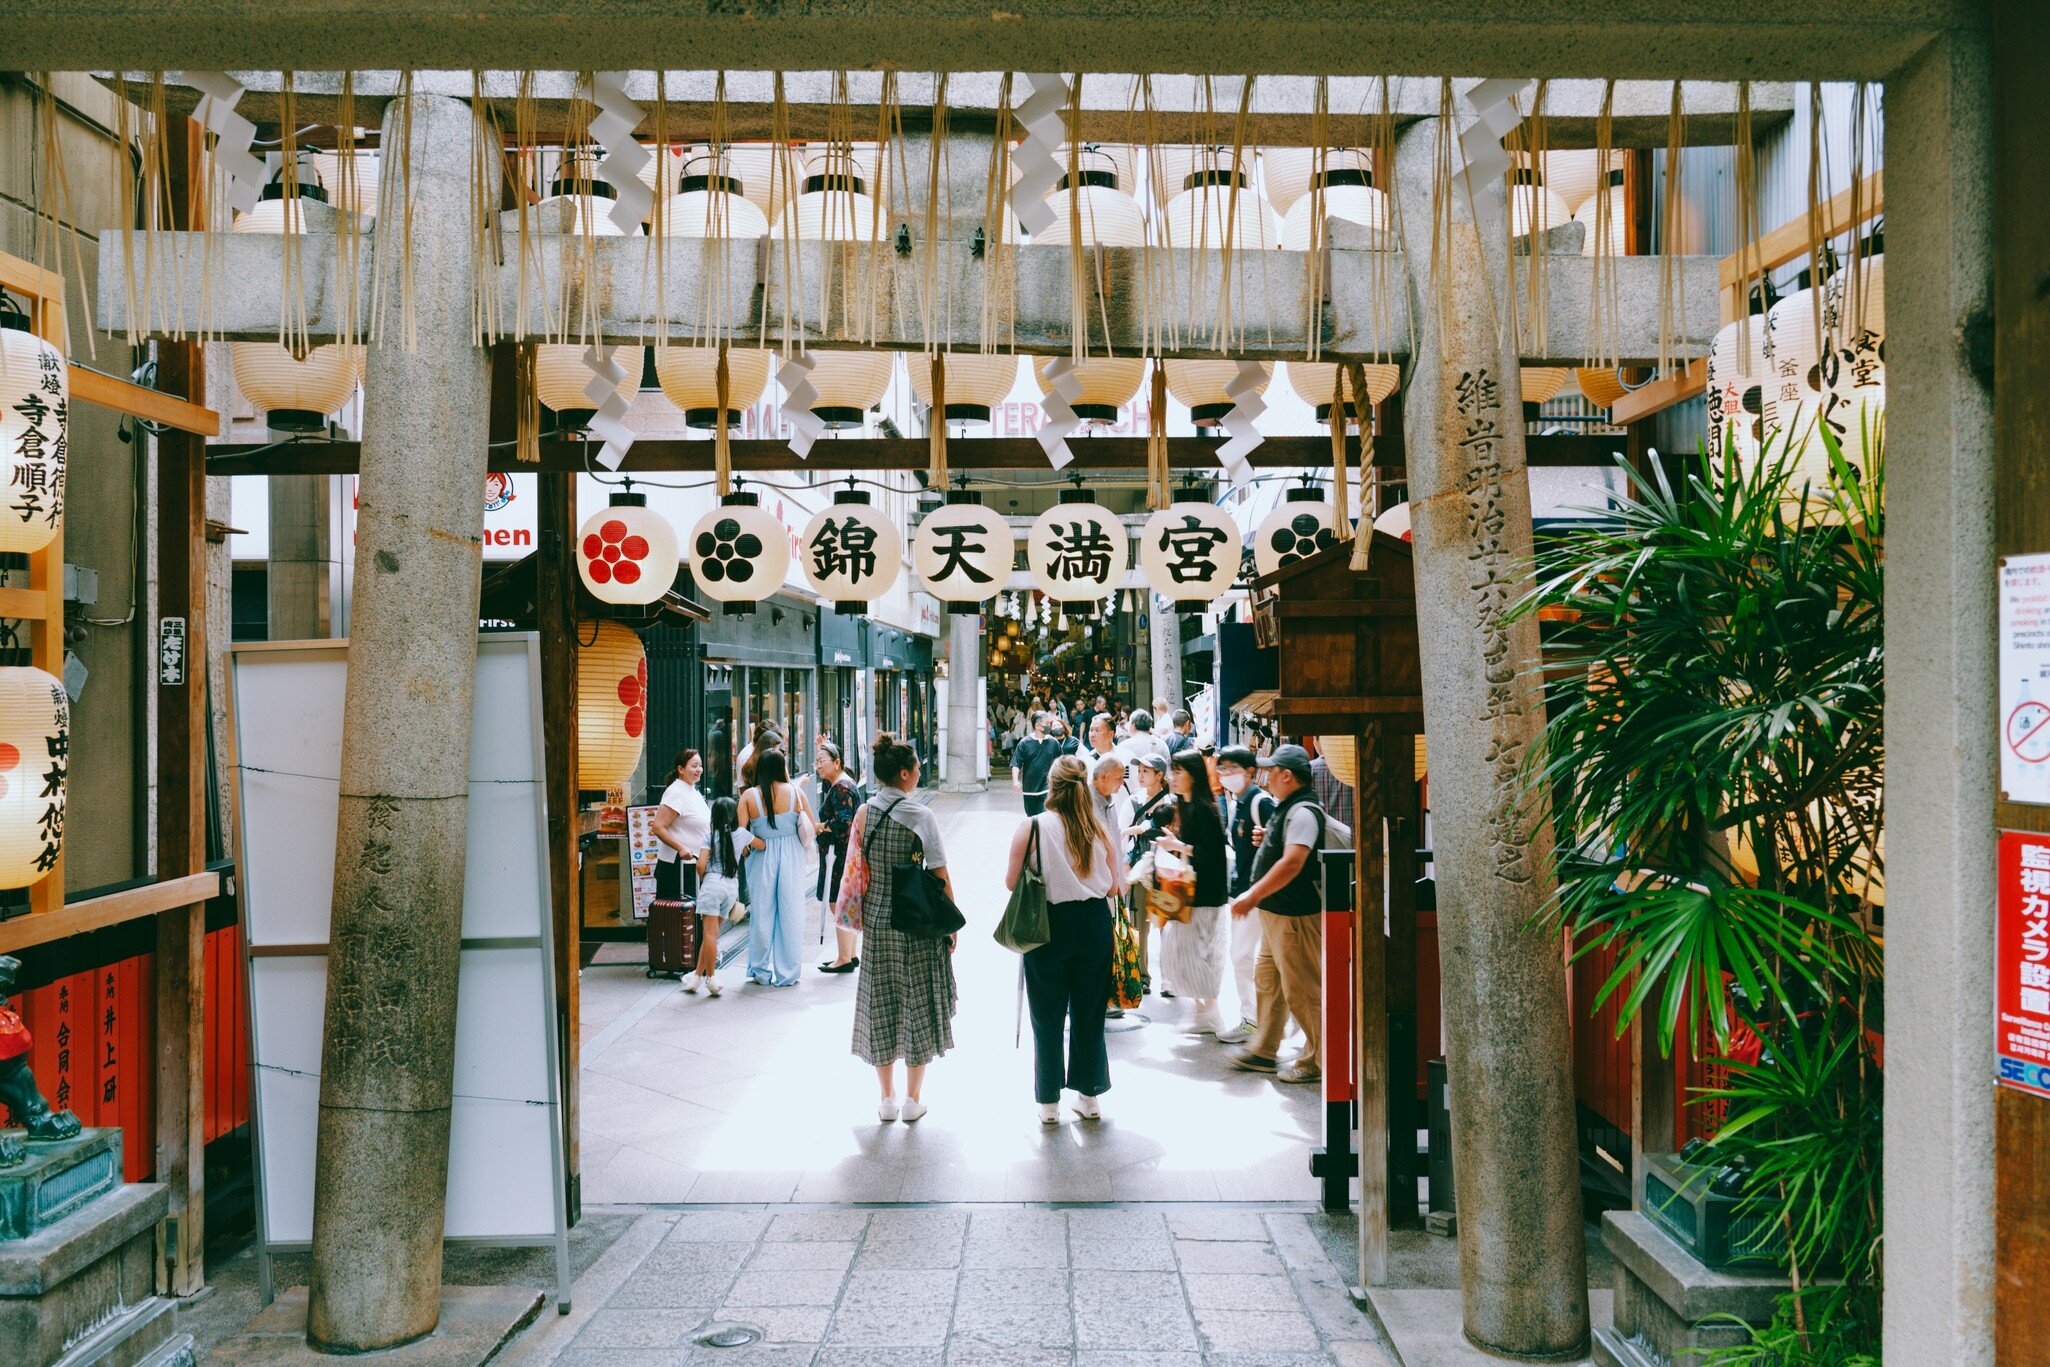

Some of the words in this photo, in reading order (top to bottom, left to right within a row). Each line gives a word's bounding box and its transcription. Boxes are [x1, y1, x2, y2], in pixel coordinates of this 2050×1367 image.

[1779, 358, 1801, 402] 釜座
[10, 393, 51, 523] 寺倉順子
[2011, 619, 2039, 628] smoking
[2013, 631, 2045, 640] precincts
[2013, 642, 2035, 650] Shinto
[2020, 843, 2050, 1015] 監視カメラ設置
[56, 1020, 71, 1109] 合同会
